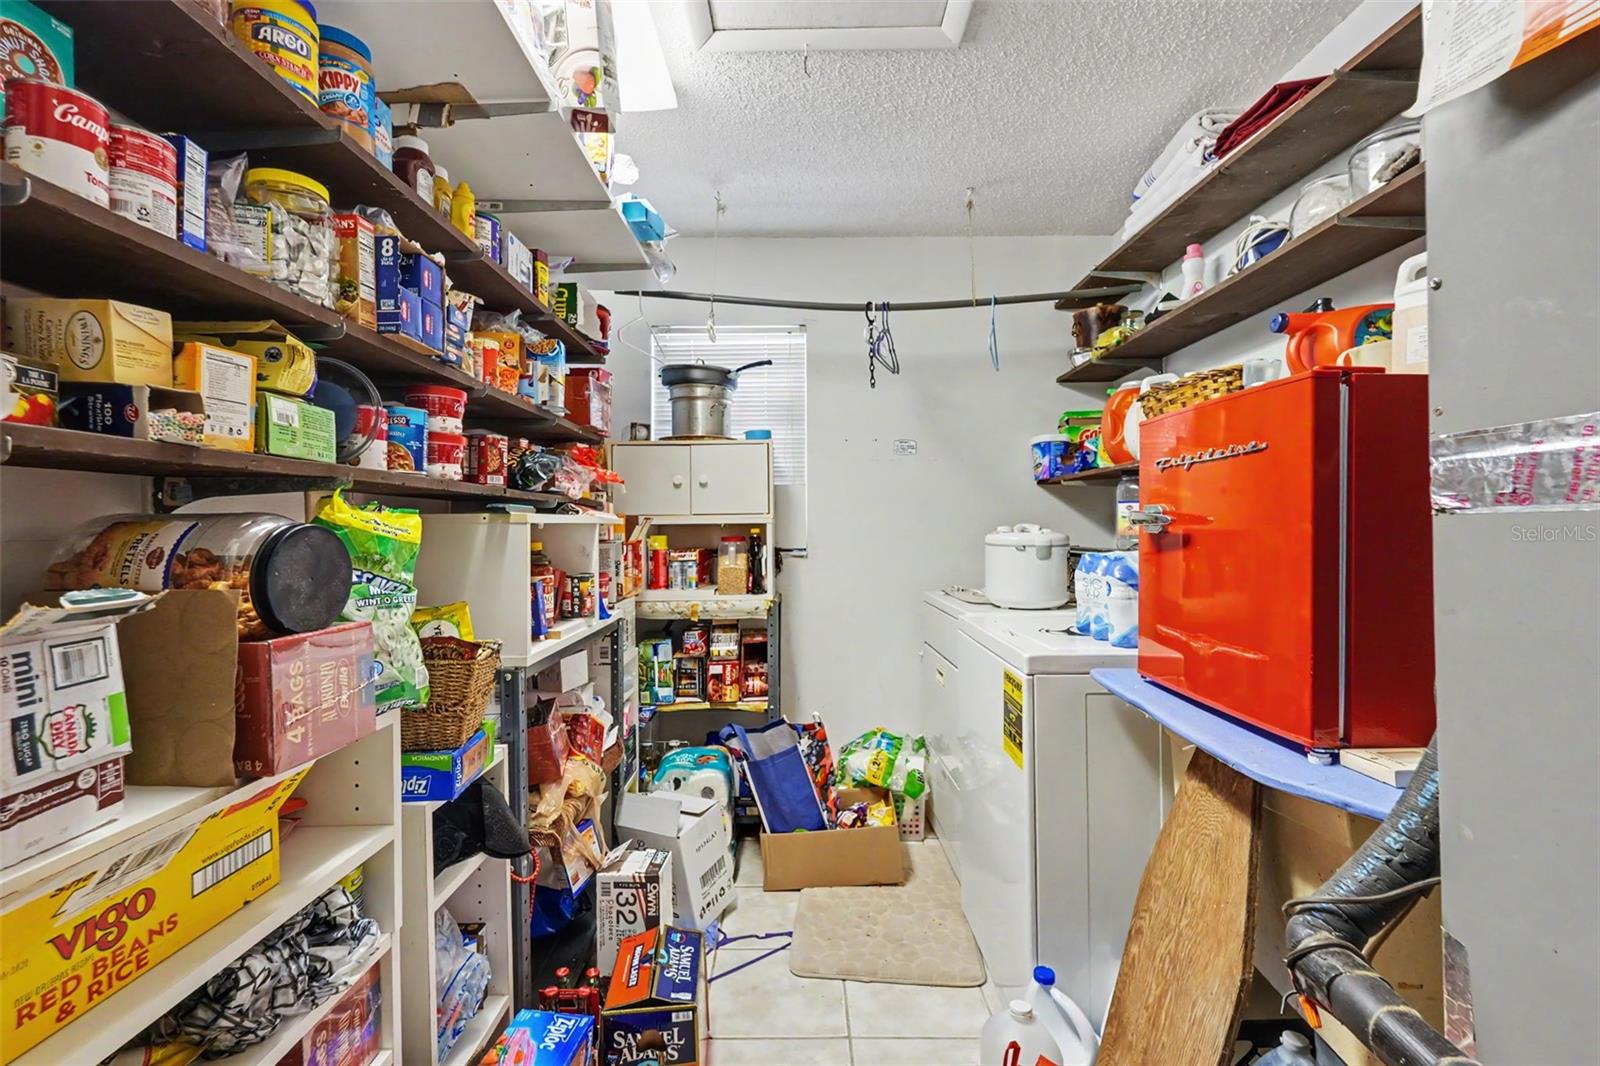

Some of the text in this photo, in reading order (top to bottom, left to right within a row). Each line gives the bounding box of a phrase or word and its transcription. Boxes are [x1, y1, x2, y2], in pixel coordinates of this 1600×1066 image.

[258, 27, 307, 56] ARGO
[258, 51, 280, 66] CORN
[381, 238, 394, 257] 8
[77, 317, 90, 366] TWININGS
[104, 402, 112, 425] 100
[1155, 441, 1268, 472] Frigidaire
[119, 533, 149, 586] PRETZELS
[356, 597, 380, 608] WINT
[11, 651, 43, 709] mini
[20, 720, 33, 767] ZERO SUGAR
[50, 721, 65, 749] DRY
[64, 706, 79, 757] CANADA
[286, 726, 306, 744] 4
[615, 892, 638, 925] 32
[646, 883, 659, 916] OWYN
[607, 899, 615, 941] Chocolate
[15, 913, 179, 1030] RED BEANS
[664, 944, 681, 981] ADAMS
[677, 945, 695, 984] SAMUEL
[55, 951, 150, 1024] & RICE
[540, 1017, 576, 1051] Ziploc
